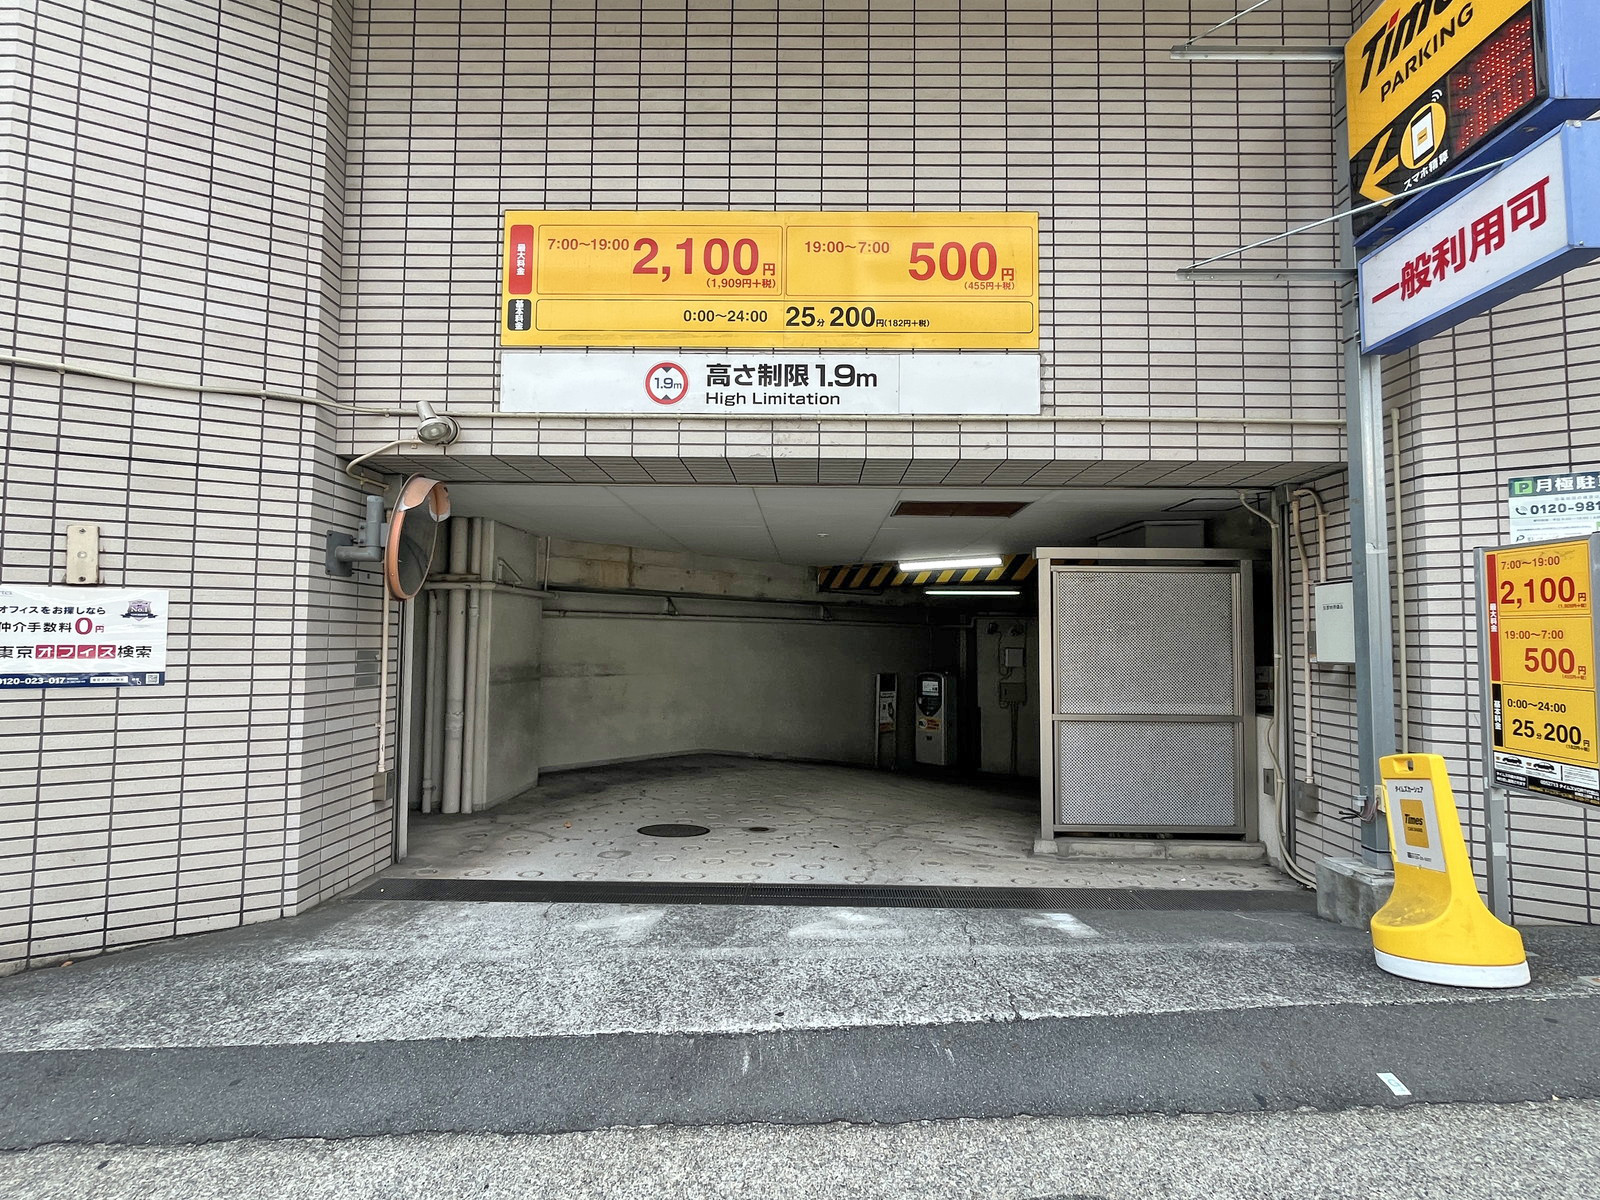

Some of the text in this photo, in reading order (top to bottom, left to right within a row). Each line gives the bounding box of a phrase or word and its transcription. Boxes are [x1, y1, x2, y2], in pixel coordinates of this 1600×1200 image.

[1380, 2, 1474, 102] PARKING
[1403, 149, 1450, 192] スマホ精算
[1371, 175, 1550, 304] 一般利用可
[632, 237, 776, 282] 2,100円
[908, 241, 1015, 281] 500円
[654, 377, 682, 389] 1.9m
[705, 392, 840, 406] High Limitation
[1536, 476, 1600, 493] 月極駐
[1500, 576, 1586, 609] 2,100円
[0, 605, 106, 615] オフィスをお探しなら
[0, 645, 153, 659] 東京オフィス検索
[1524, 647, 1587, 675] 500円
[1404, 813, 1424, 826] Times
